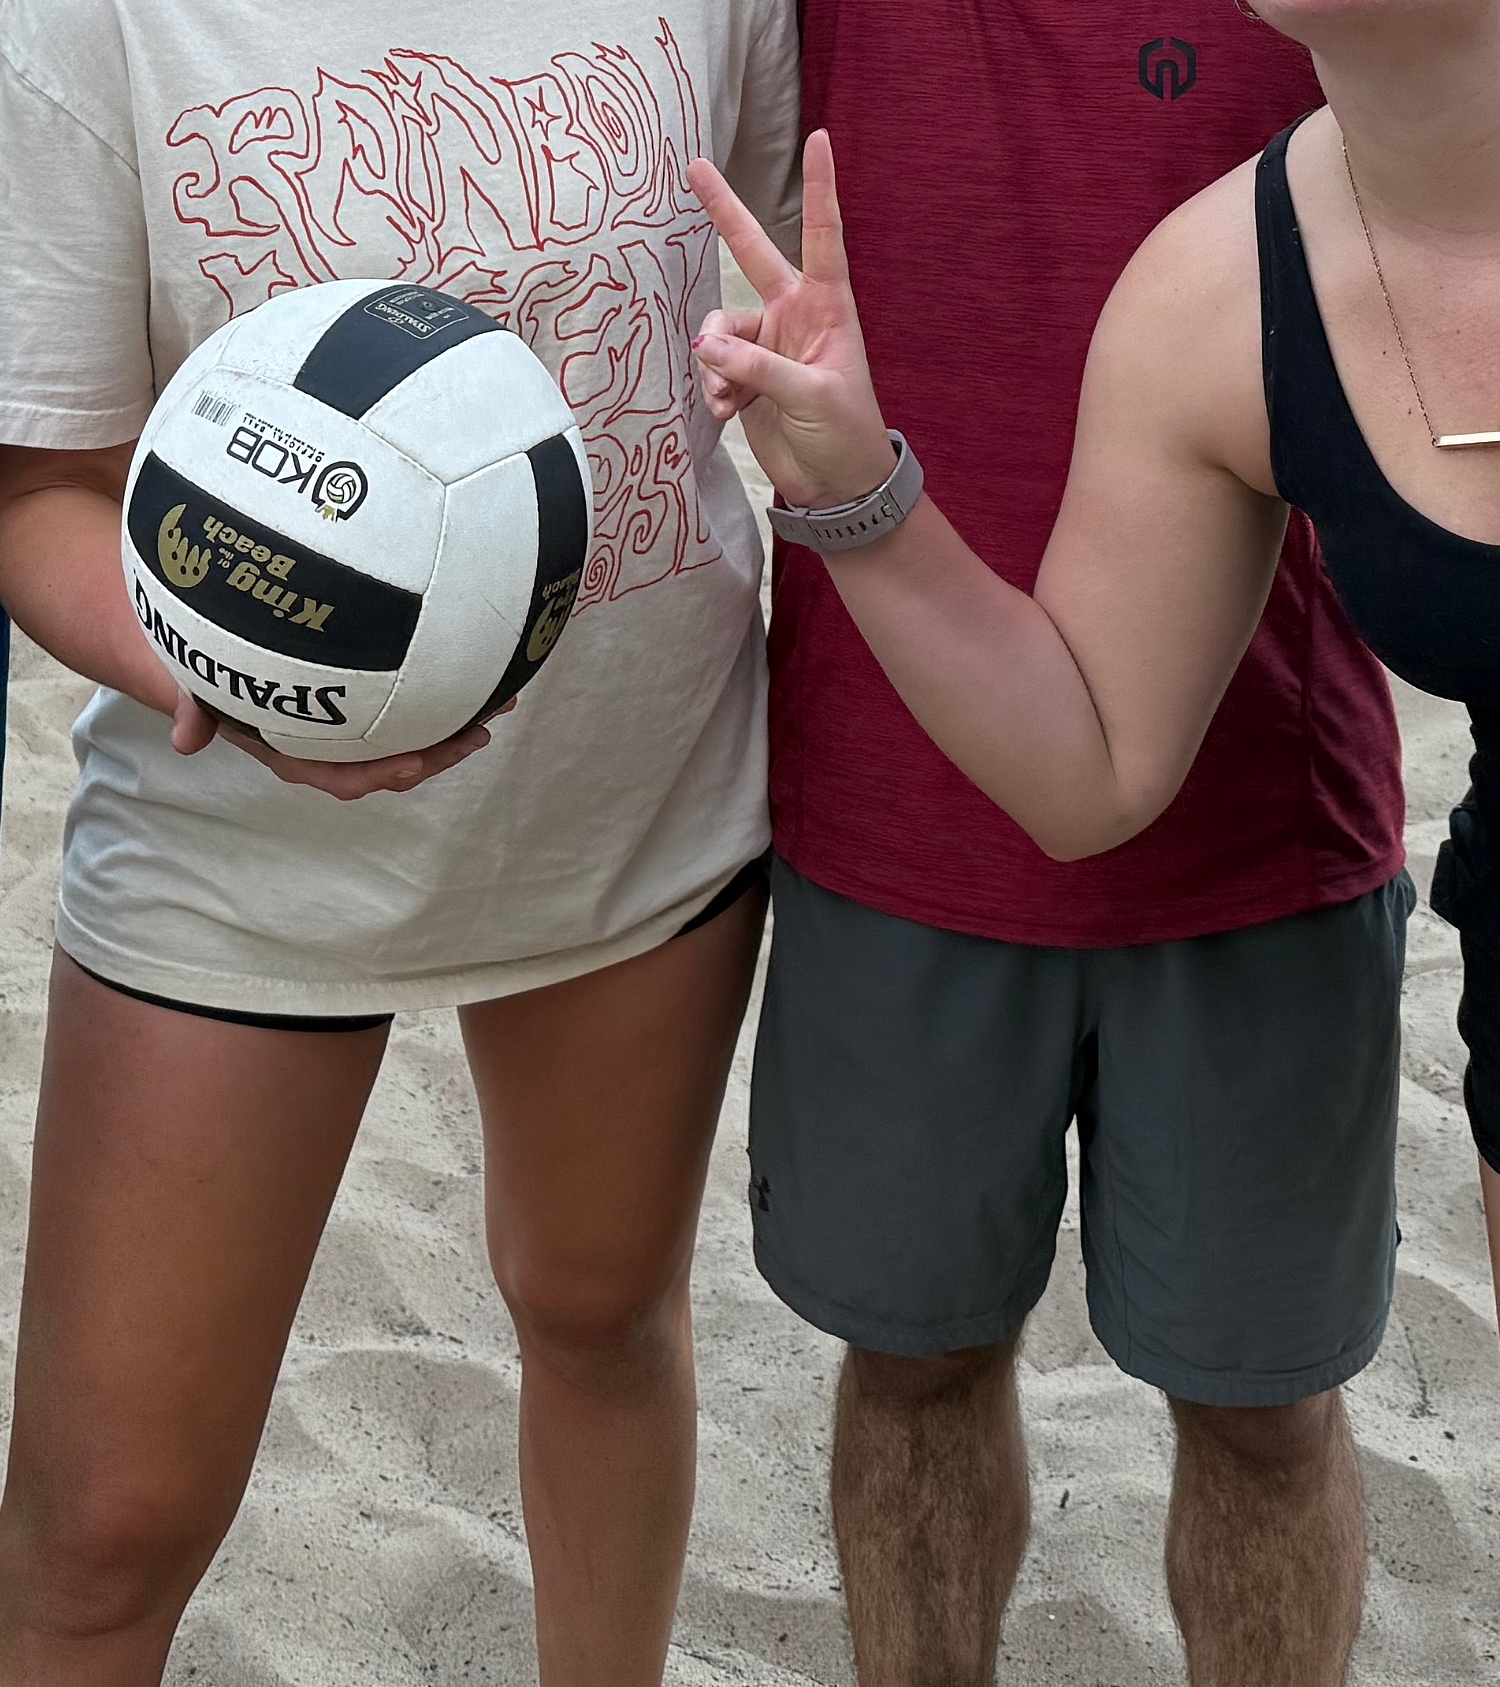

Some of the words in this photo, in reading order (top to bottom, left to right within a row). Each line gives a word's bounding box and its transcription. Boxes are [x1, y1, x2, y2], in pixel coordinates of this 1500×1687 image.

[226, 426, 318, 494] KOB
[203, 516, 297, 581] Beach
[226, 561, 335, 632] King
[134, 574, 347, 725] SPALDING
